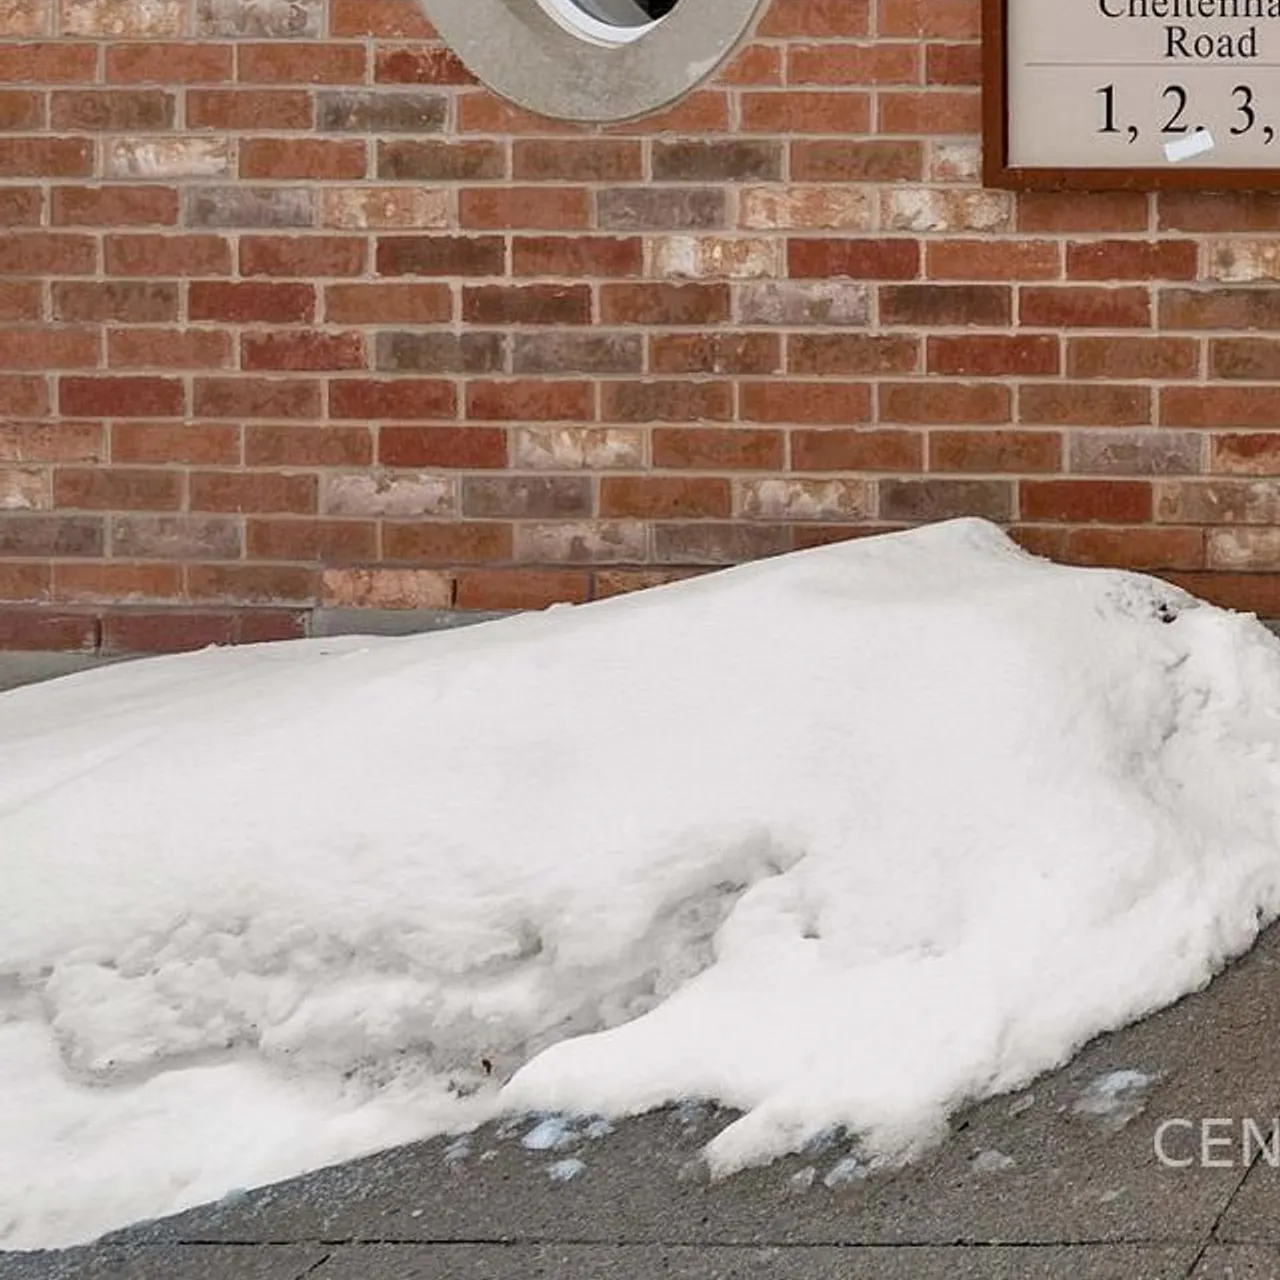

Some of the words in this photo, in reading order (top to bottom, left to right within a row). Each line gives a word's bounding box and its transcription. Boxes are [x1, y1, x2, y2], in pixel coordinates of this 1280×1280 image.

[1164, 25, 1259, 58] Road
[1096, 83, 1139, 145] 1,
[1229, 84, 1274, 145] 3,
